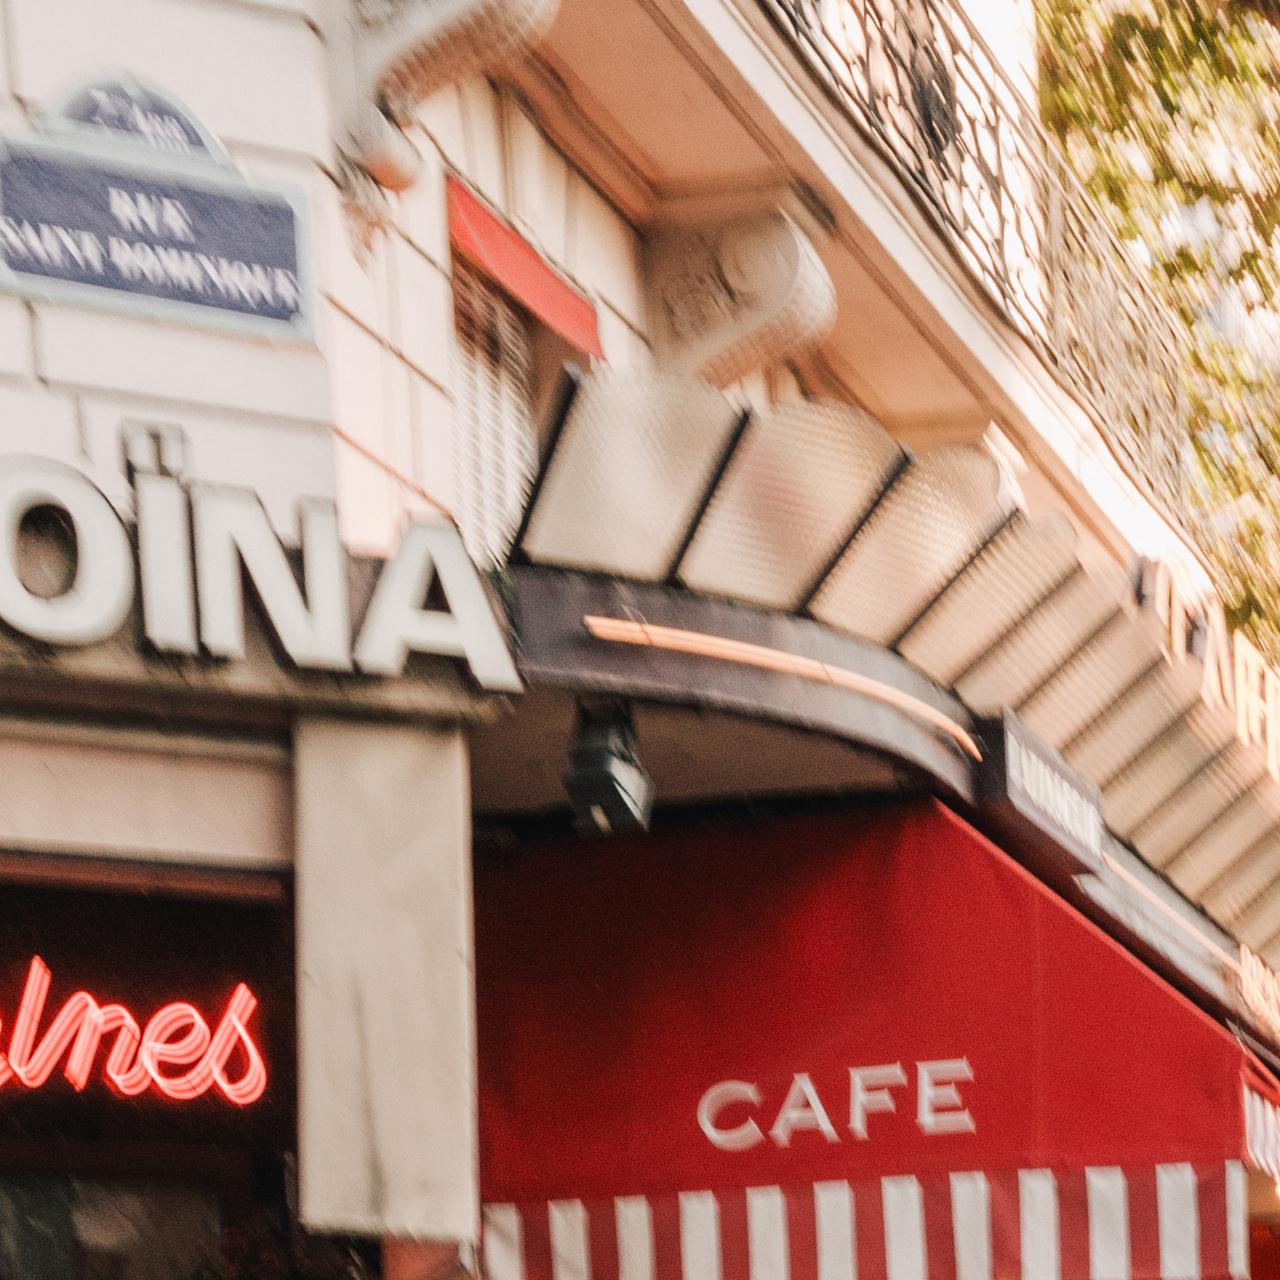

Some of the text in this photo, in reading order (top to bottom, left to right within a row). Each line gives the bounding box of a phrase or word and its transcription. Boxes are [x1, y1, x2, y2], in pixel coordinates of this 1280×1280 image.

[106, 185, 198, 246] RUE
[0, 420, 524, 694] OÏNA
[696, 1055, 977, 1152] CAFE
